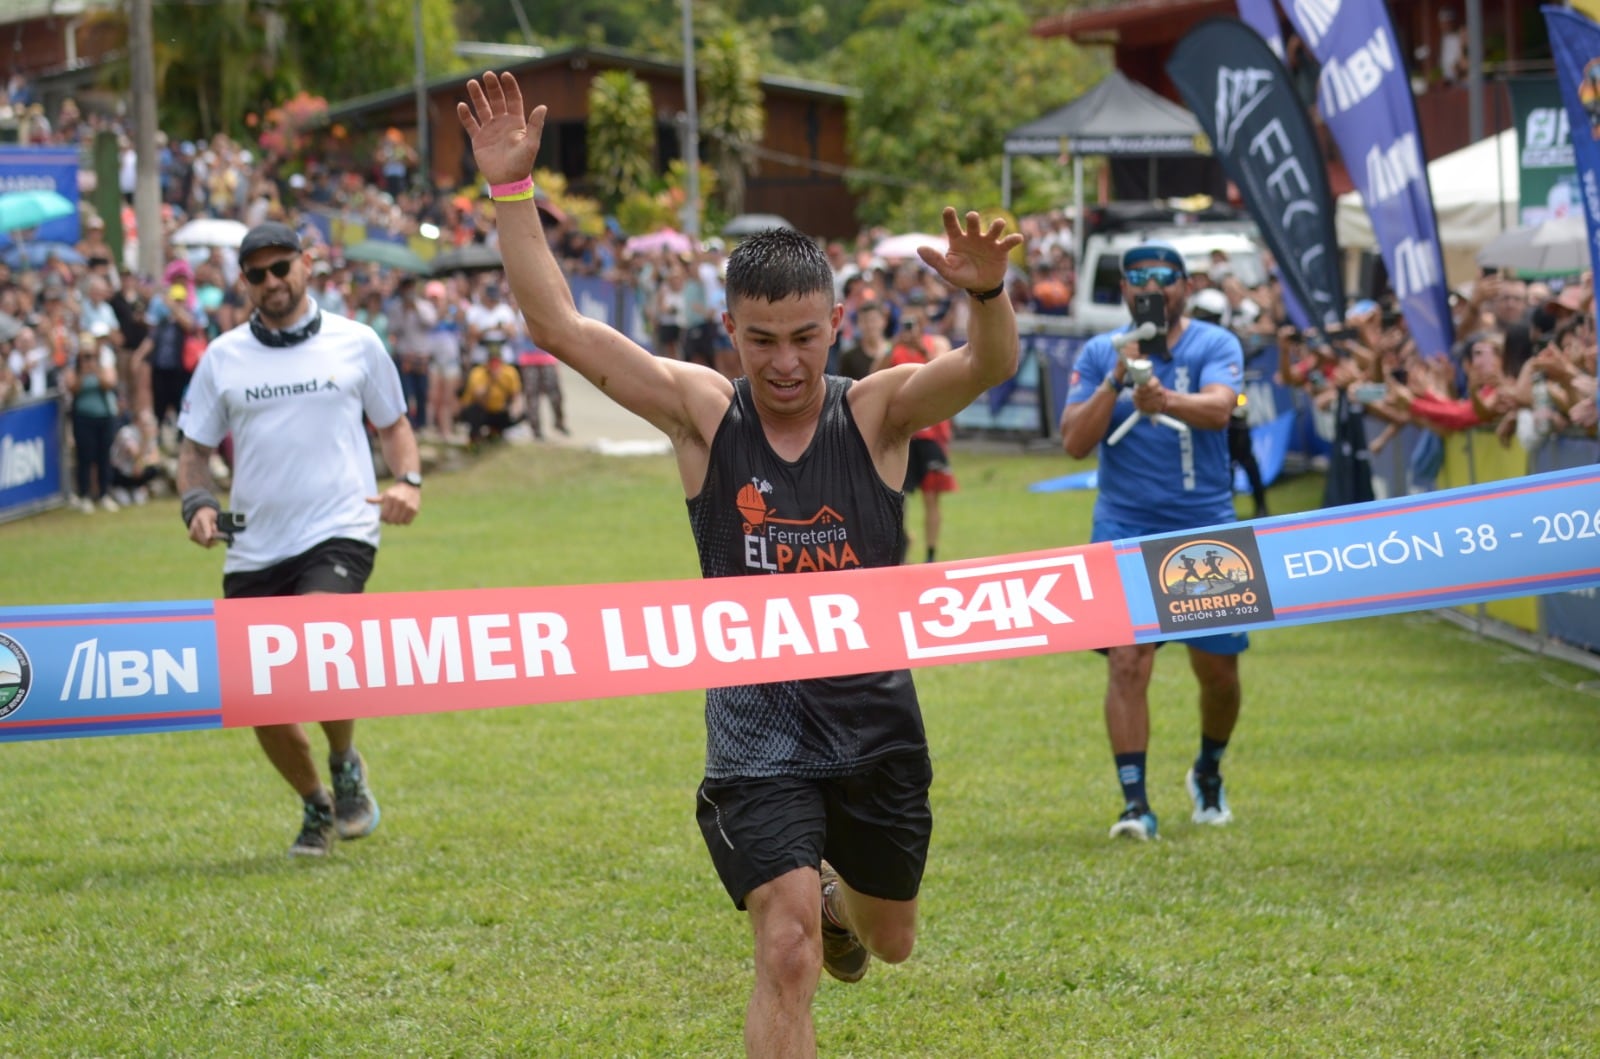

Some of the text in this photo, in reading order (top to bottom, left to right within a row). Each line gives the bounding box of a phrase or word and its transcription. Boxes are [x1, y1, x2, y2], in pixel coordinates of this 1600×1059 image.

[776, 541, 861, 573] PANA
[1283, 530, 1445, 580] EDICIÓN
[1455, 523, 1499, 555] 38
[917, 572, 1075, 639] 34K
[1168, 587, 1257, 614] CHIRRIPÓ
[1171, 610, 1213, 623] EDICIÓN
[1215, 609, 1228, 618] 38
[1235, 605, 1259, 615] 2026
[247, 592, 869, 696] PRIMER LUGAR
